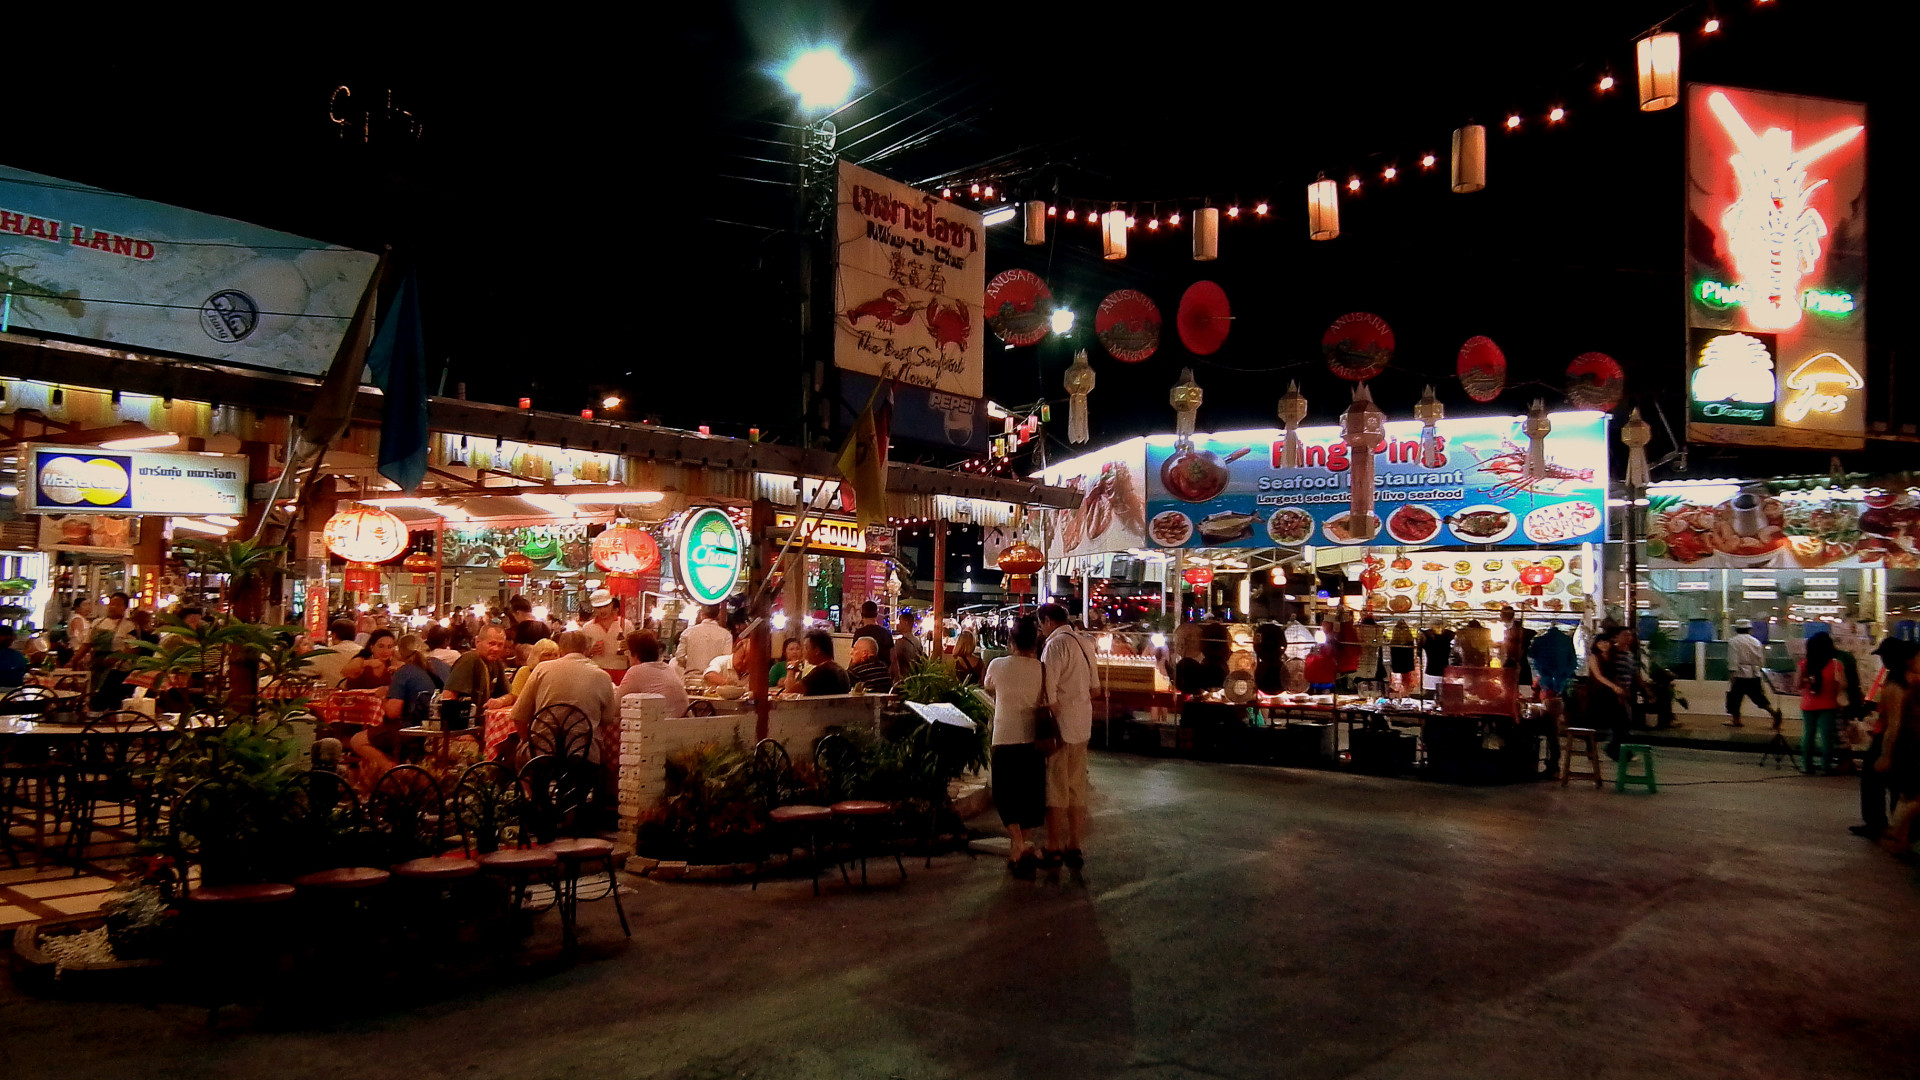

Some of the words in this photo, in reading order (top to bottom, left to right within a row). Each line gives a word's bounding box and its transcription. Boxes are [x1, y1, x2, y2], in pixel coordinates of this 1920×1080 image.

[71, 226, 156, 261] LAND
[986, 269, 1045, 299] ANUSARN
[1100, 289, 1156, 315] ANUSARN
[1330, 311, 1390, 335] ANUSARN
[858, 331, 881, 354] The
[884, 338, 913, 361] Best
[1328, 358, 1377, 379] MART
[929, 391, 975, 415] PEPSI
[1258, 473, 1339, 490] Seafood
[1346, 470, 1463, 487] staurant
[1257, 494, 1304, 505] Largest
[1306, 492, 1353, 502] selectio
[1383, 490, 1405, 500] live
[1410, 489, 1462, 499] seafood
[866, 525, 895, 537] PEPSI
[692, 545, 738, 570] Chang
